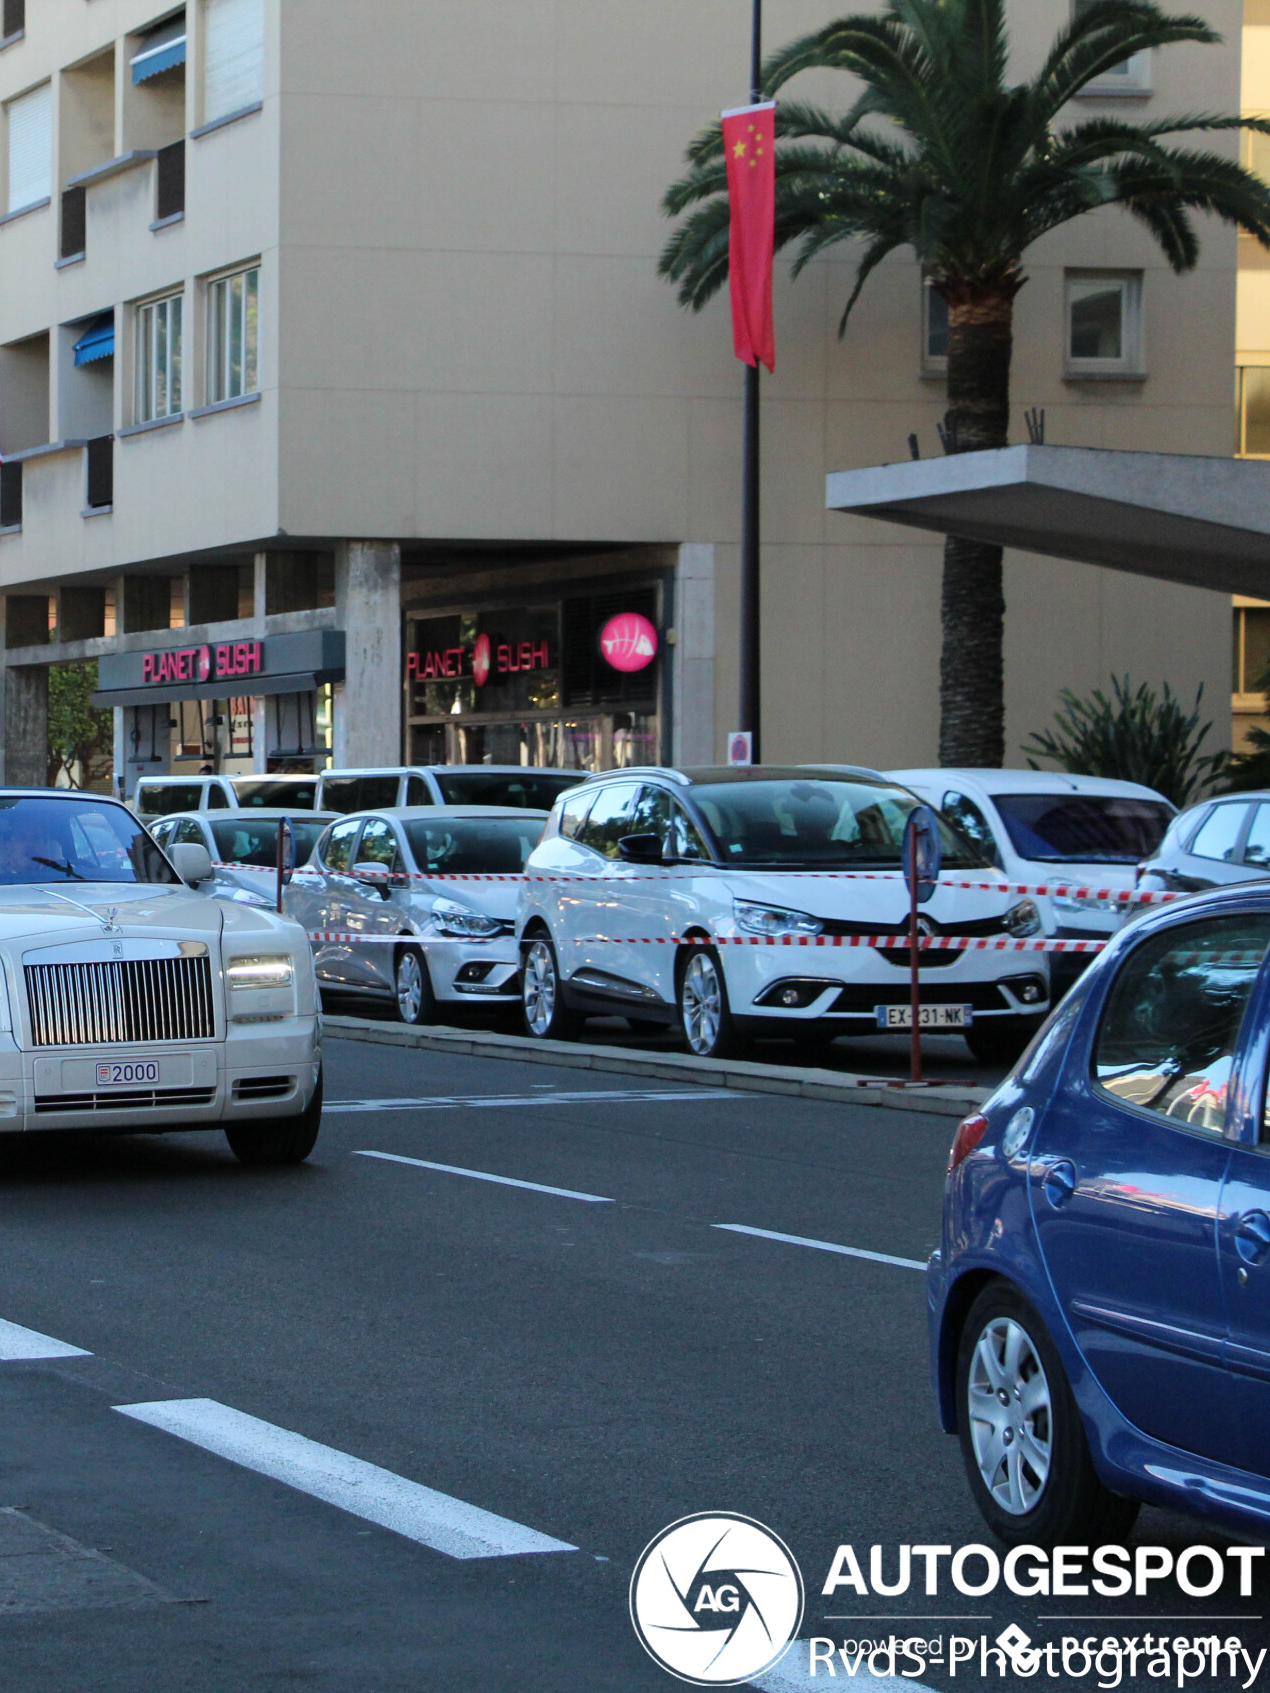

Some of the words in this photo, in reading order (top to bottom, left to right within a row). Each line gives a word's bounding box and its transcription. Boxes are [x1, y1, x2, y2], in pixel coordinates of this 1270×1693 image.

[142, 649, 197, 682] PLANET
[216, 641, 262, 676] SUSHI
[406, 648, 465, 679] PLANET
[497, 640, 549, 672] SUSHI
[888, 1008, 962, 1024] EX-31-NK
[112, 1064, 156, 1082] 2000
